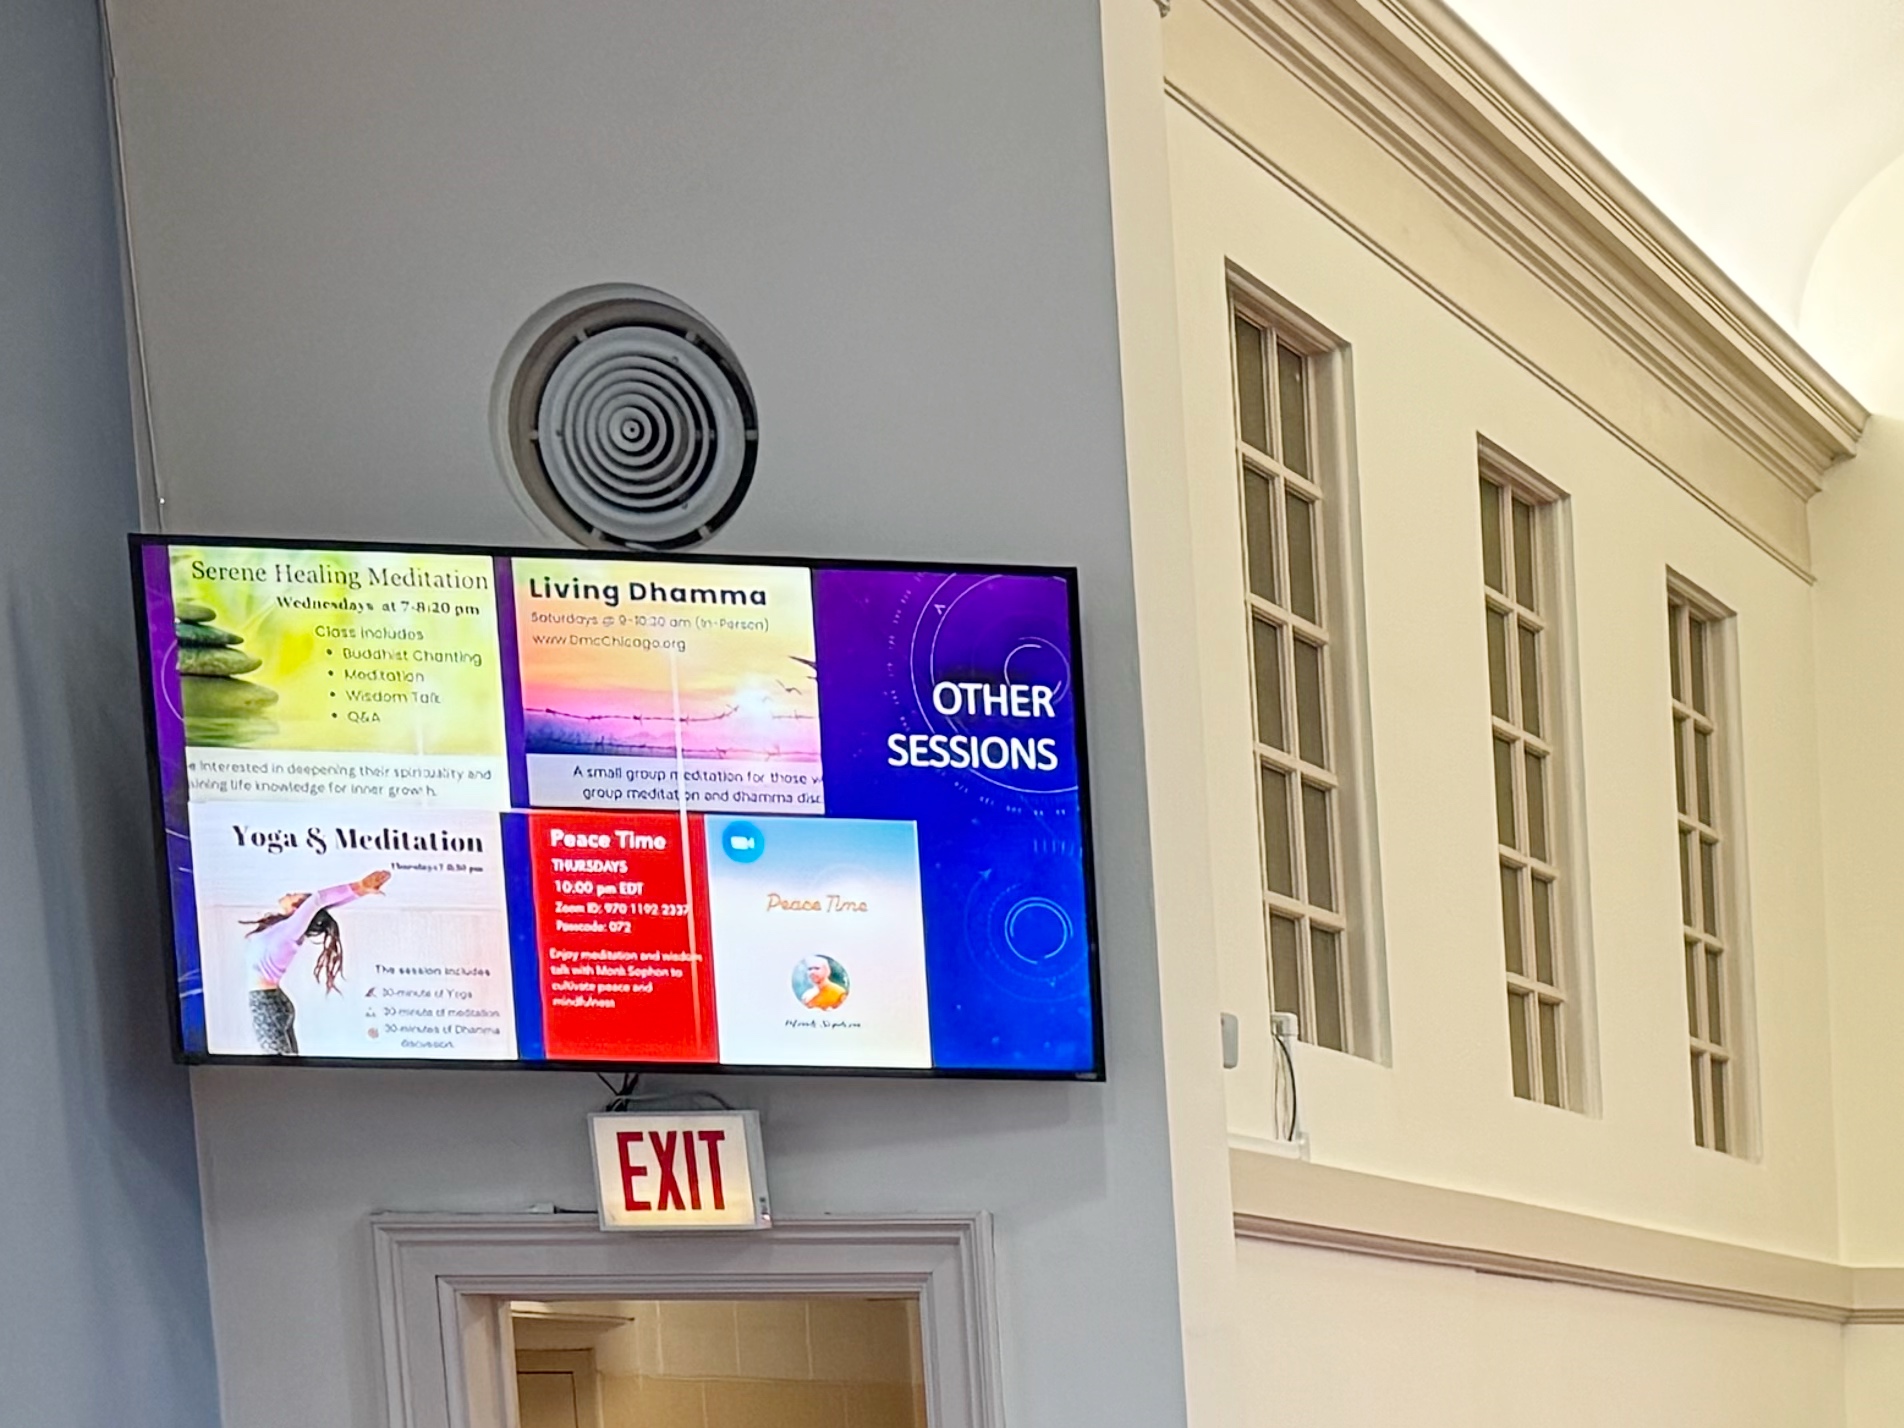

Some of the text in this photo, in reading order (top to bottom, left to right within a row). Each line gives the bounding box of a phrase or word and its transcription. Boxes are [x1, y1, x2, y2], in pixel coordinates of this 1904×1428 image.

[191, 560, 489, 591] Serene Healing Meditation
[529, 576, 767, 607] Living Dhamma
[276, 596, 374, 616] Wednesdays
[382, 599, 398, 612] at
[454, 604, 481, 617] pm
[531, 611, 599, 627] Saturdays
[669, 617, 692, 629] am
[315, 625, 424, 641] Class includes
[343, 647, 482, 666] Buddhist Chanting
[344, 668, 425, 683] Meditation
[346, 690, 441, 704] Wisdom Talk
[932, 680, 1056, 718] OTHER
[347, 710, 381, 723] Q&A
[887, 732, 1059, 771] SESSIONS
[200, 759, 268, 774] interested
[272, 761, 284, 774] in
[287, 762, 356, 778] deepening
[359, 763, 390, 777] their
[468, 767, 492, 781] and
[573, 765, 583, 778] A
[587, 766, 622, 780] small
[626, 768, 666, 783] group
[747, 771, 765, 784] for
[771, 772, 807, 786] those
[255, 780, 325, 796] knowledge
[328, 781, 347, 794] for
[351, 782, 383, 796] inner
[582, 788, 622, 802] group
[627, 788, 700, 803] meditaton
[704, 790, 729, 803] and
[732, 791, 793, 804] dhamma
[232, 824, 484, 855] Yoga & Meditation
[550, 828, 667, 850] Peace Time
[551, 858, 629, 874] THURSDAYS
[596, 883, 617, 897] pm
[619, 881, 644, 896] EDT
[766, 892, 869, 913] Peace Time
[616, 1129, 726, 1212] EXIT
